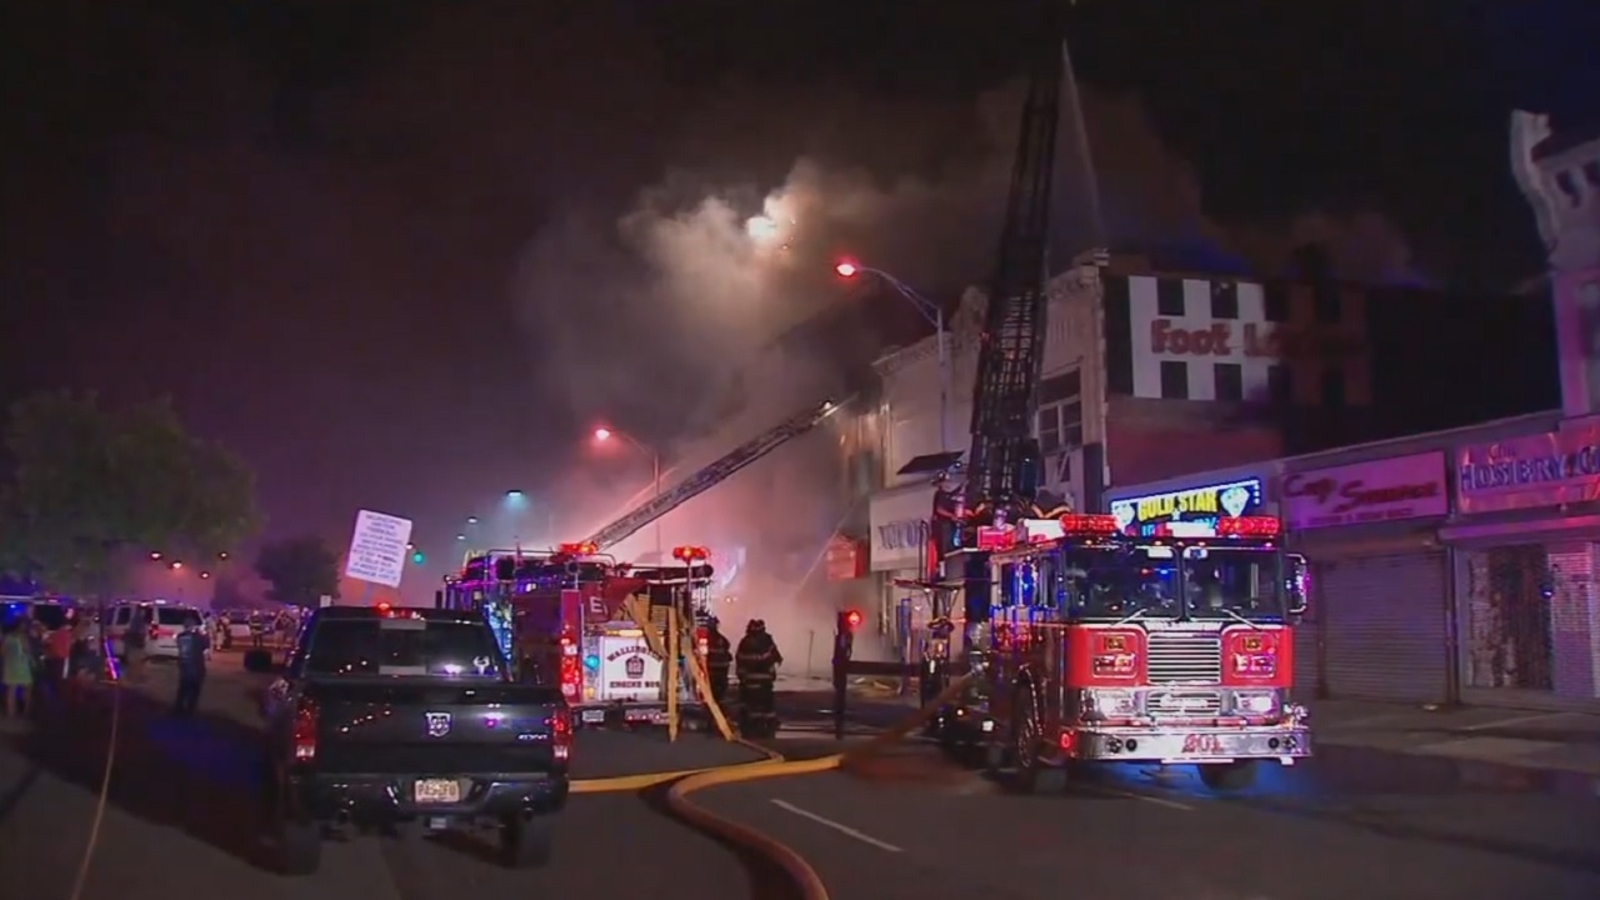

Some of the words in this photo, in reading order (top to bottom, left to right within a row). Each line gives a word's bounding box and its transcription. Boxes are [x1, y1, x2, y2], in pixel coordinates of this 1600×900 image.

[1151, 319, 1232, 356] Foot
[1460, 453, 1567, 492] HOSIERY
[1138, 496, 1175, 521] GOLD
[1178, 488, 1217, 513] STAR
